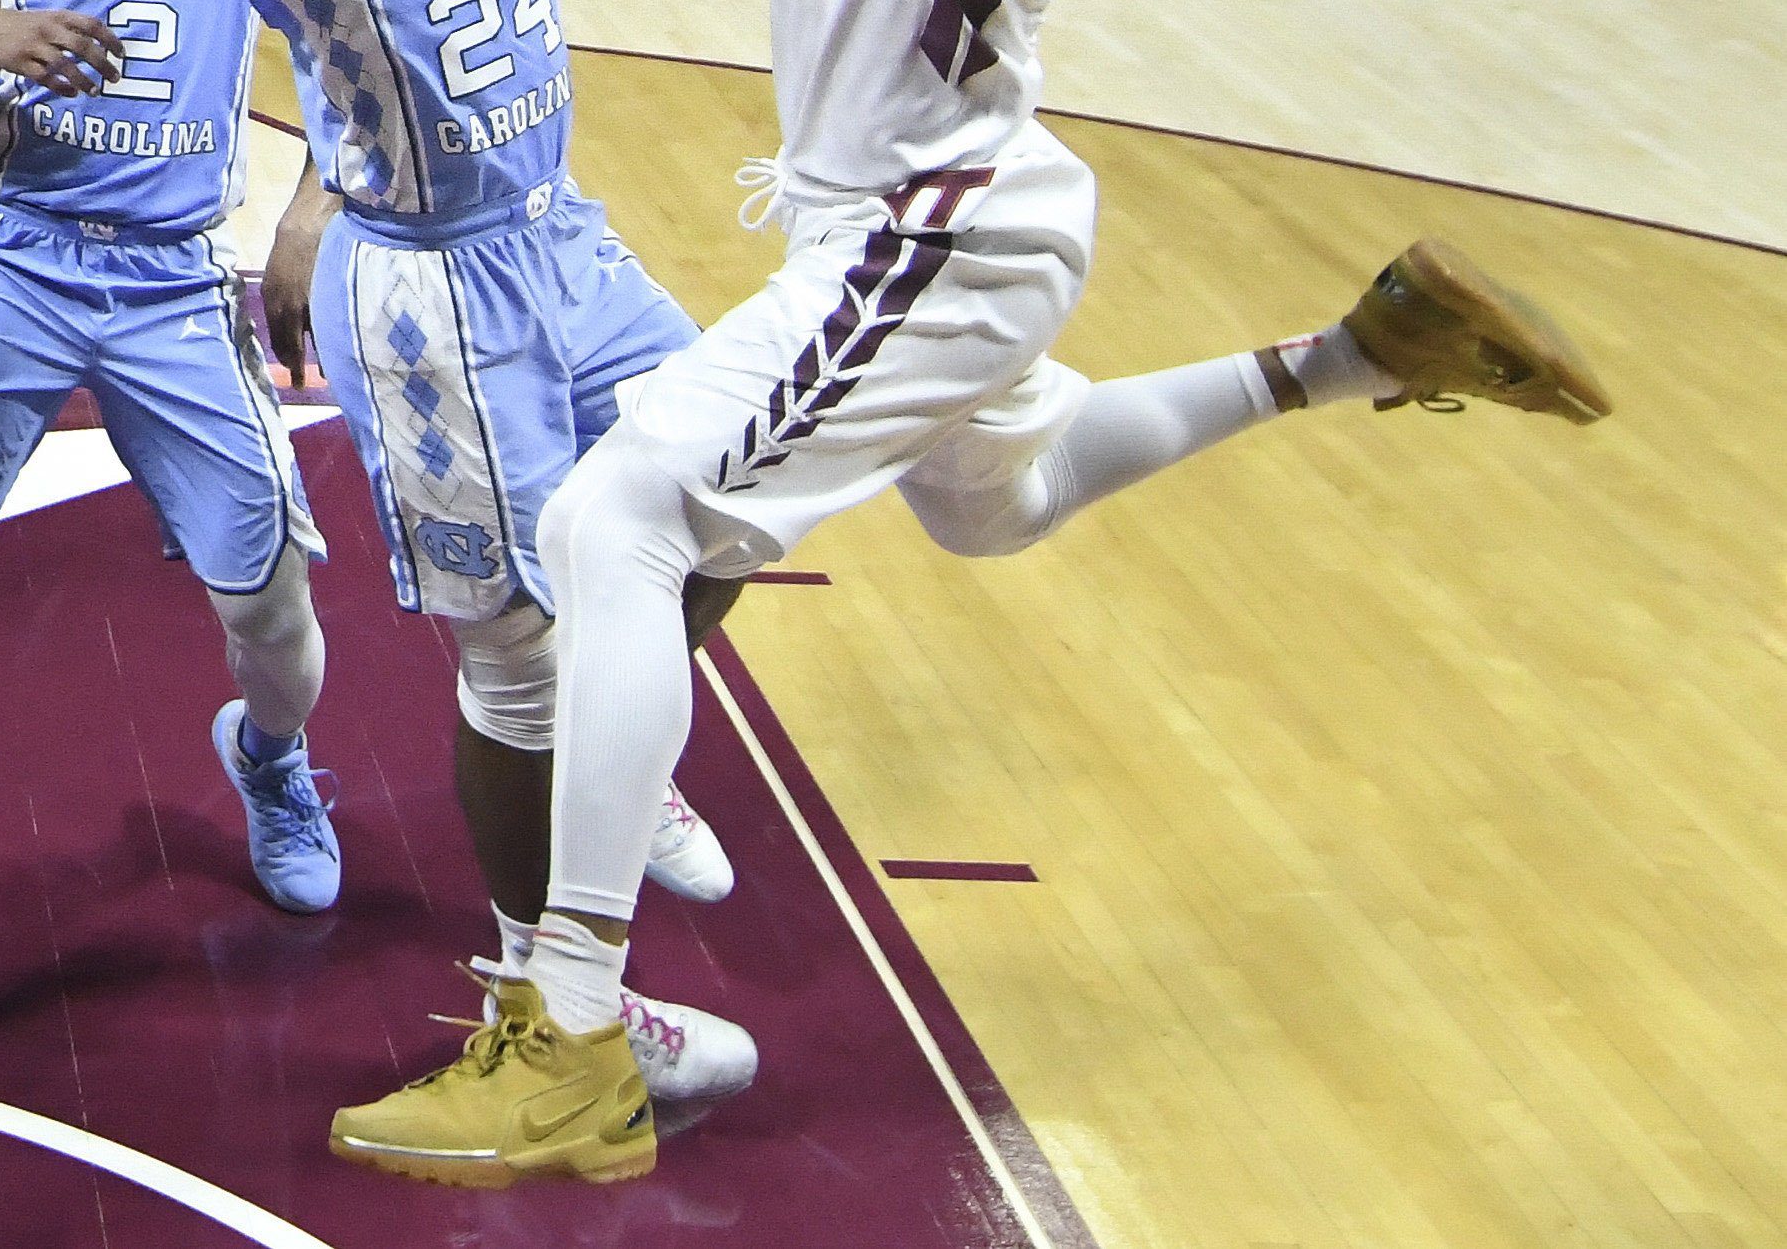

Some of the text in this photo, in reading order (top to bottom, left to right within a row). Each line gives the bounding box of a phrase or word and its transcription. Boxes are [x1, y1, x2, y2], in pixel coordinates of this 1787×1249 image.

[100, 0, 179, 102] 2
[31, 102, 215, 158] CAROLINA
[436, 64, 571, 155] CAROLIN
